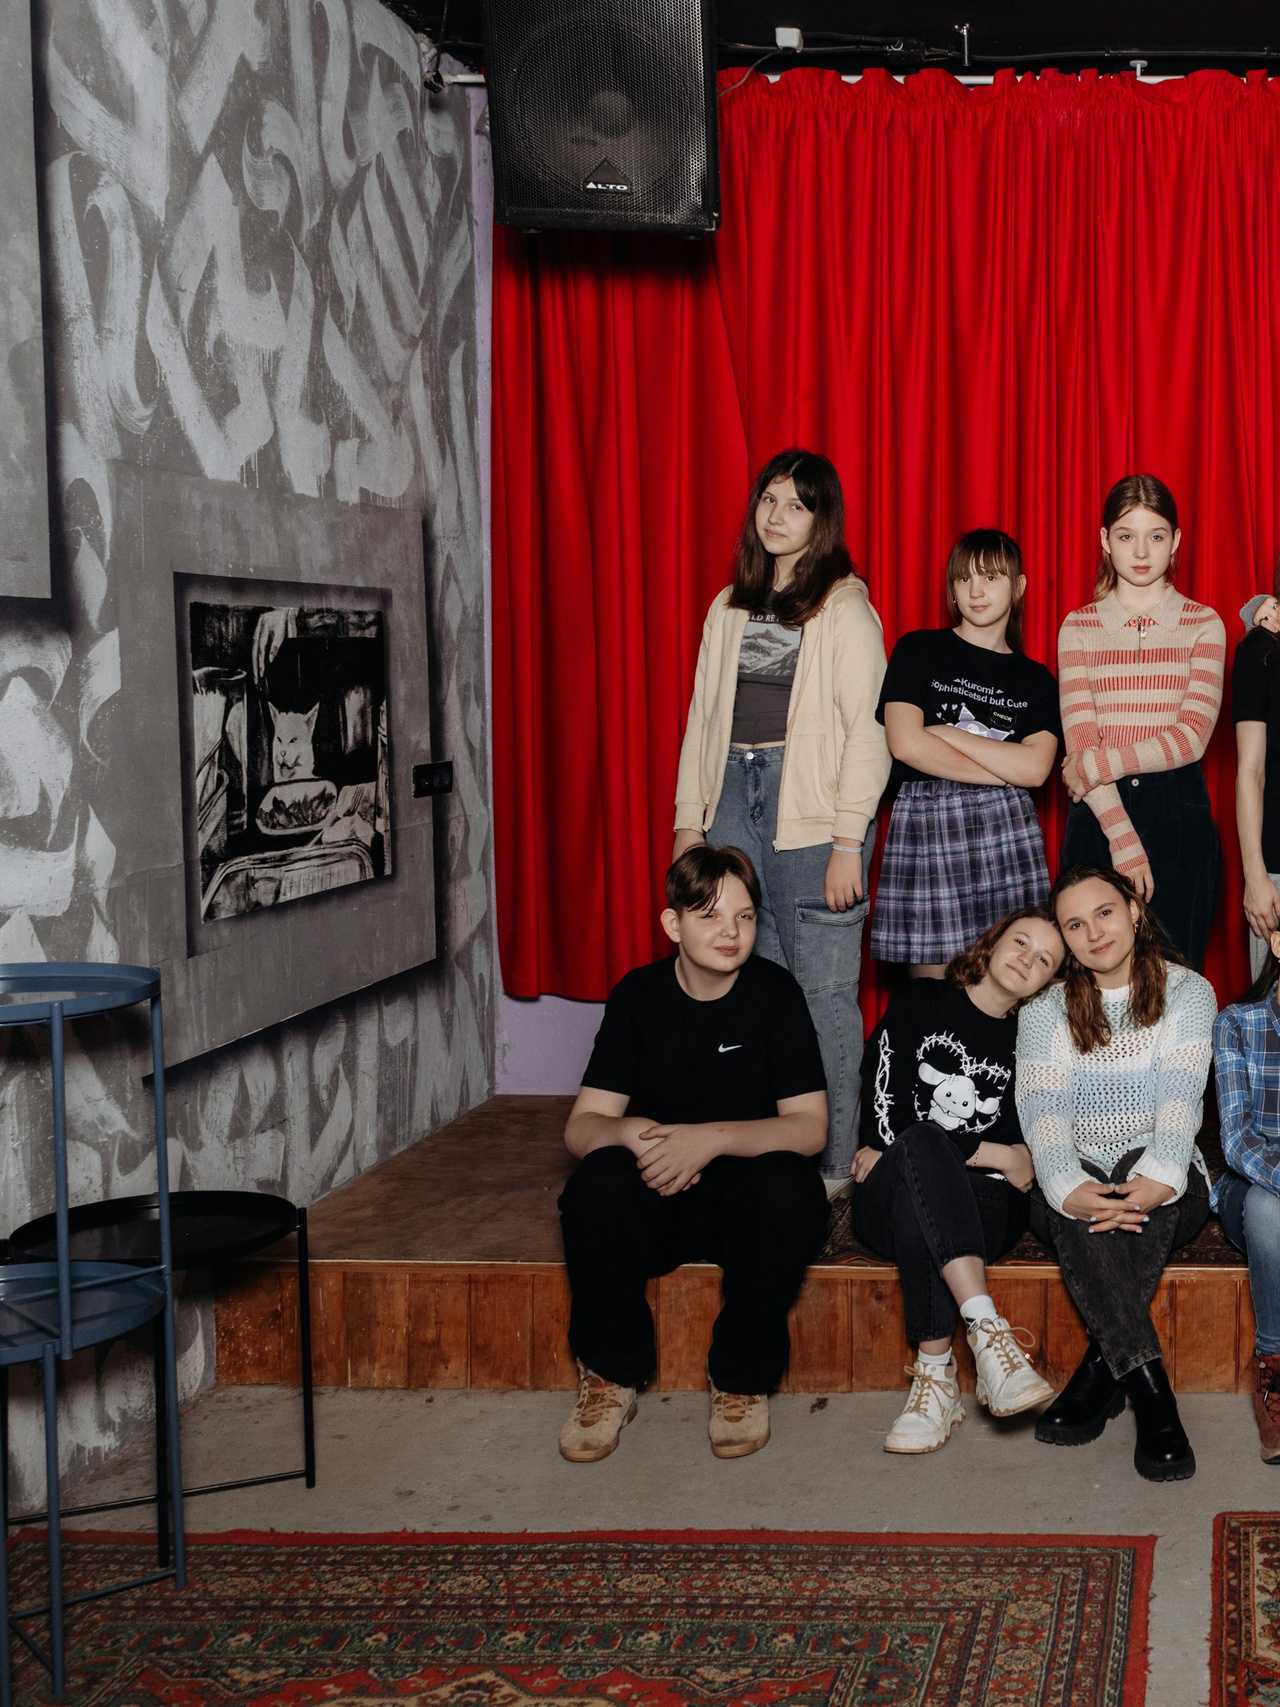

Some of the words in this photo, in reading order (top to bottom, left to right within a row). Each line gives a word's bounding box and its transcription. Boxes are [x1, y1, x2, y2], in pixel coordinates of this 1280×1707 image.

[586, 182, 628, 190] ALTO
[961, 678, 995, 695] Kuromi
[989, 696, 1005, 707] but
[1006, 698, 1028, 708] Cute
[992, 711, 1013, 722] CHECK
